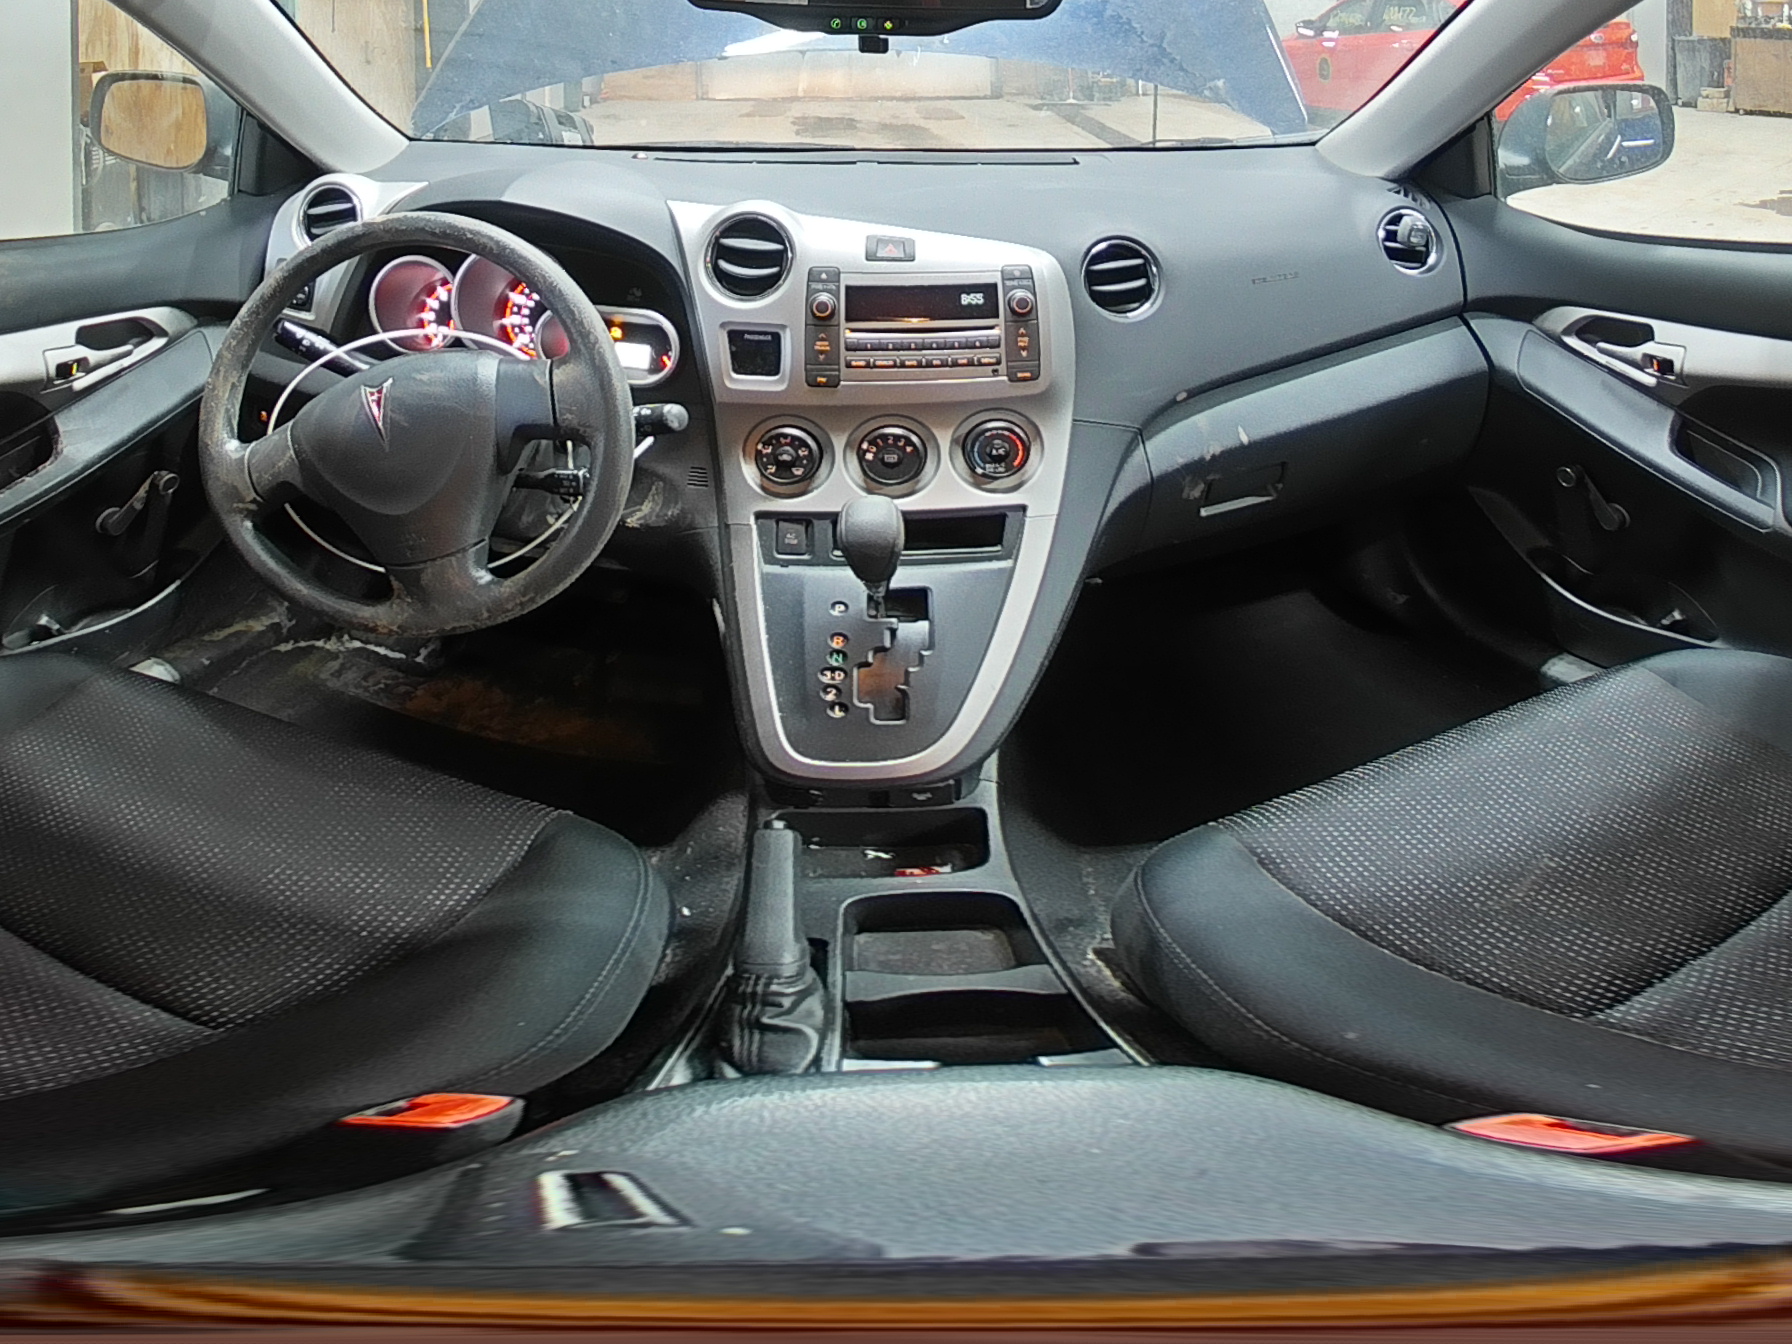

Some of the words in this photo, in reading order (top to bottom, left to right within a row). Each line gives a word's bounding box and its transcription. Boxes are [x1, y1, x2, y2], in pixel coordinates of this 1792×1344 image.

[835, 603, 845, 613] P
[833, 636, 845, 647] R
[831, 653, 844, 664] N
[826, 687, 837, 697] 2
[834, 705, 845, 716] L
